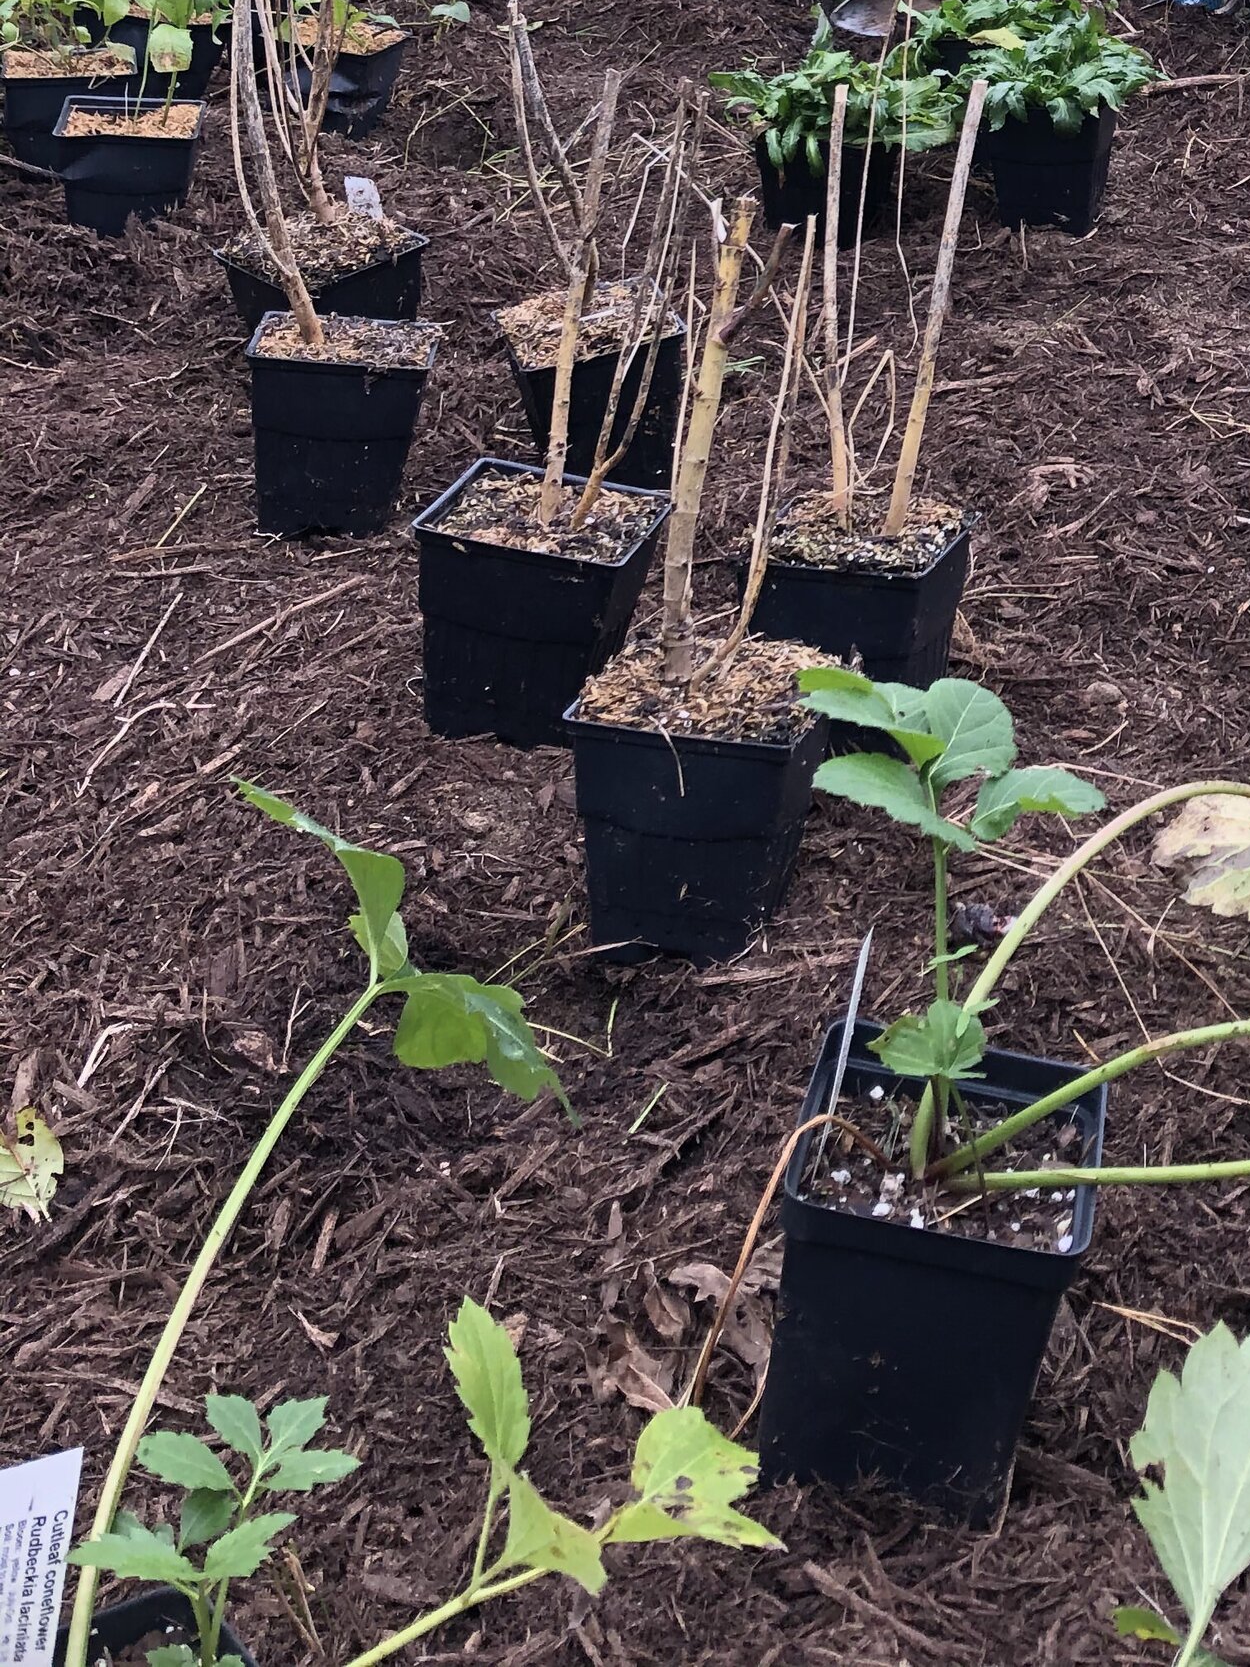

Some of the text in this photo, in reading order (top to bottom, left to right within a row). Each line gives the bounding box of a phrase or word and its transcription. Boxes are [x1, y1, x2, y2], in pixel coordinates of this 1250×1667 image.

[13, 1515, 47, 1663] Rudbeckia laciniata
[35, 1509, 69, 1651] Cutleaf coneflower
